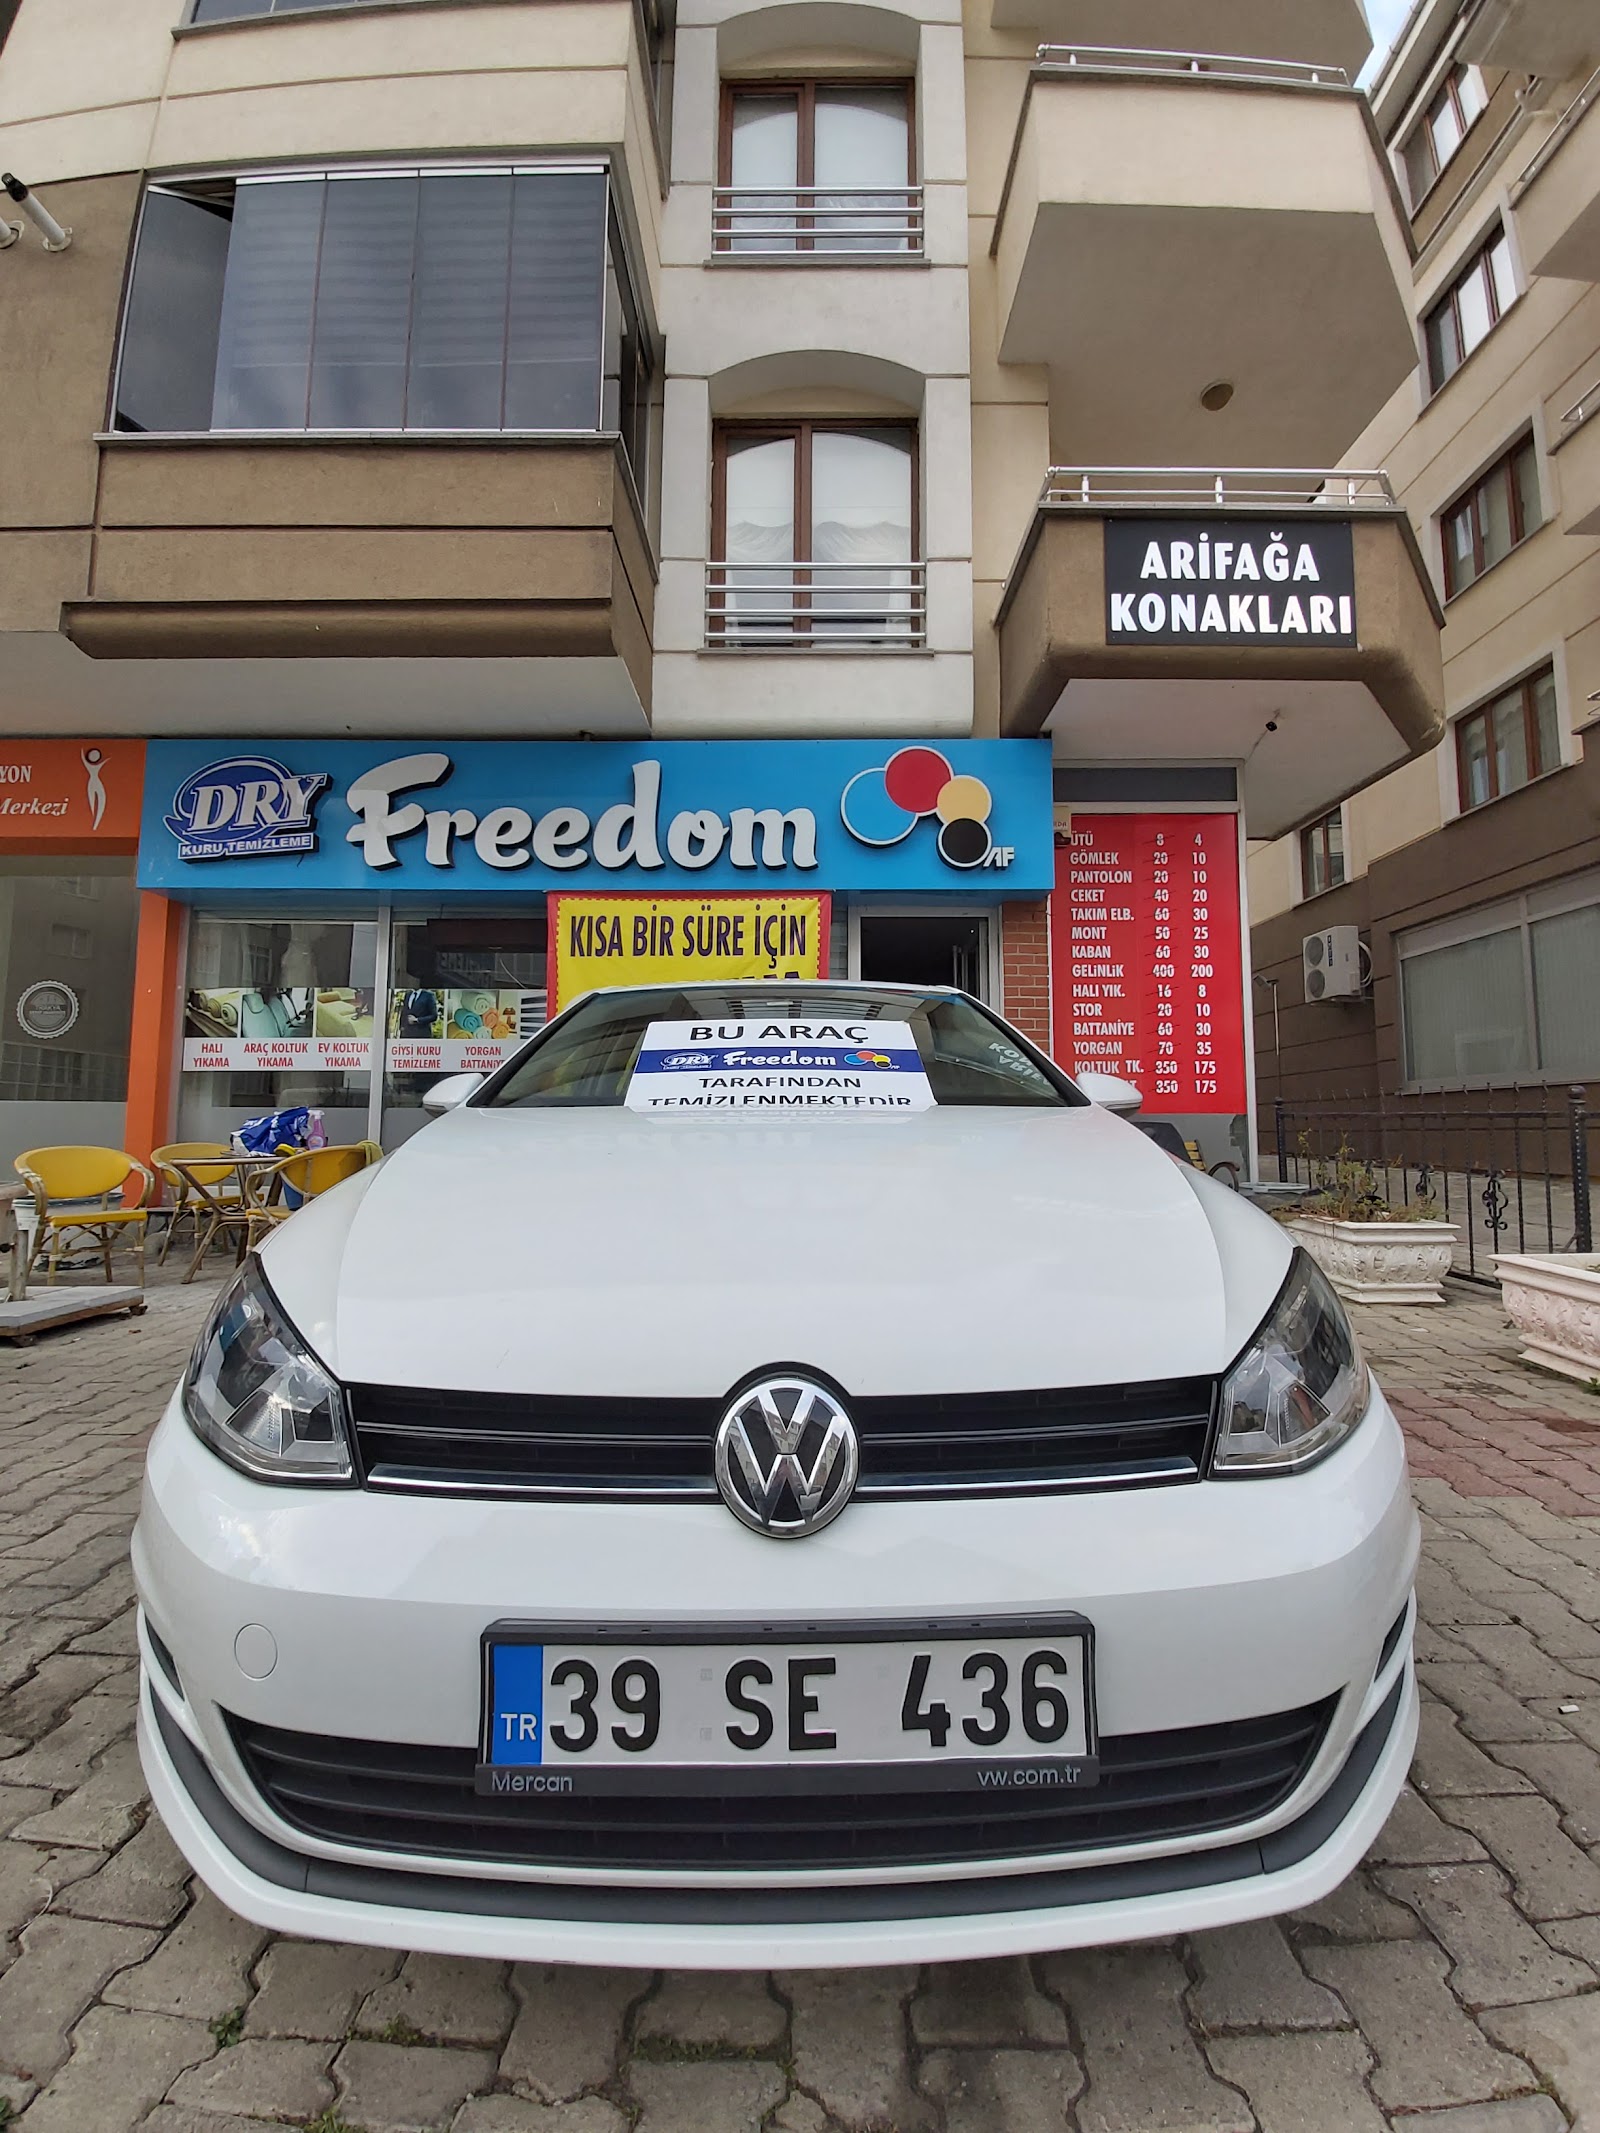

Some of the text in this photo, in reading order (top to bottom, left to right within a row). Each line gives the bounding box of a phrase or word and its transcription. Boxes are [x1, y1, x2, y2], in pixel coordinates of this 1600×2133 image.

[1140, 531, 1320, 582] ARİFAĞA
[1110, 592, 1352, 634] KONAKLARI
[183, 775, 325, 834] DRY
[345, 753, 818, 868] Freedom
[1071, 830, 1202, 846] ÜTÜ 8 4
[181, 836, 311, 856] KURU TEMİZLEME
[983, 846, 1015, 867] AF
[1070, 849, 1207, 865] GÖMLEK 20 10
[1070, 871, 1207, 883] PANTOLON 20 10
[1071, 889, 1208, 902] CEKET 40 20
[1071, 908, 1208, 921] TAKIM ELB. 60 30
[570, 904, 806, 969] KISA BİR SÜRE İÇİN
[1071, 927, 1209, 940] MONT 50 25
[1072, 945, 1209, 959] KABAN 60 30
[1152, 964, 1175, 978] 400
[1191, 964, 1213, 978] 200
[1072, 984, 1206, 997] HALI YIK. 16 8
[1073, 1003, 1211, 1016] STOR 20 10
[689, 1025, 869, 1044] BU ARAÇ
[1073, 1019, 1211, 1036] BATTANİYE 60 30
[201, 1043, 223, 1054] HALI
[243, 1043, 309, 1056] ARAÇ KOLTUK
[318, 1043, 369, 1054] EV KOLTUK
[391, 1043, 441, 1056] GİYSİ KURU
[465, 1046, 501, 1056] YORGAN
[1073, 1041, 1212, 1055] YORGAN 70 35
[193, 1057, 229, 1067] YIKAMA
[257, 1057, 293, 1067] YIKAMA
[325, 1057, 361, 1067] YIKAMA
[393, 1057, 441, 1068] TEMİZLEME
[723, 1050, 836, 1067] Freedom
[1074, 1060, 1216, 1074] KOLTUK TK. 350 175
[699, 1077, 861, 1088] TARAFINDAN
[1156, 1080, 1217, 1093] 350 175
[550, 1650, 1069, 1752] 39 SE 436
[500, 1713, 537, 1741] TR
[491, 1771, 573, 1793] Mercan
[977, 1763, 1081, 1787] vw.com.tr
